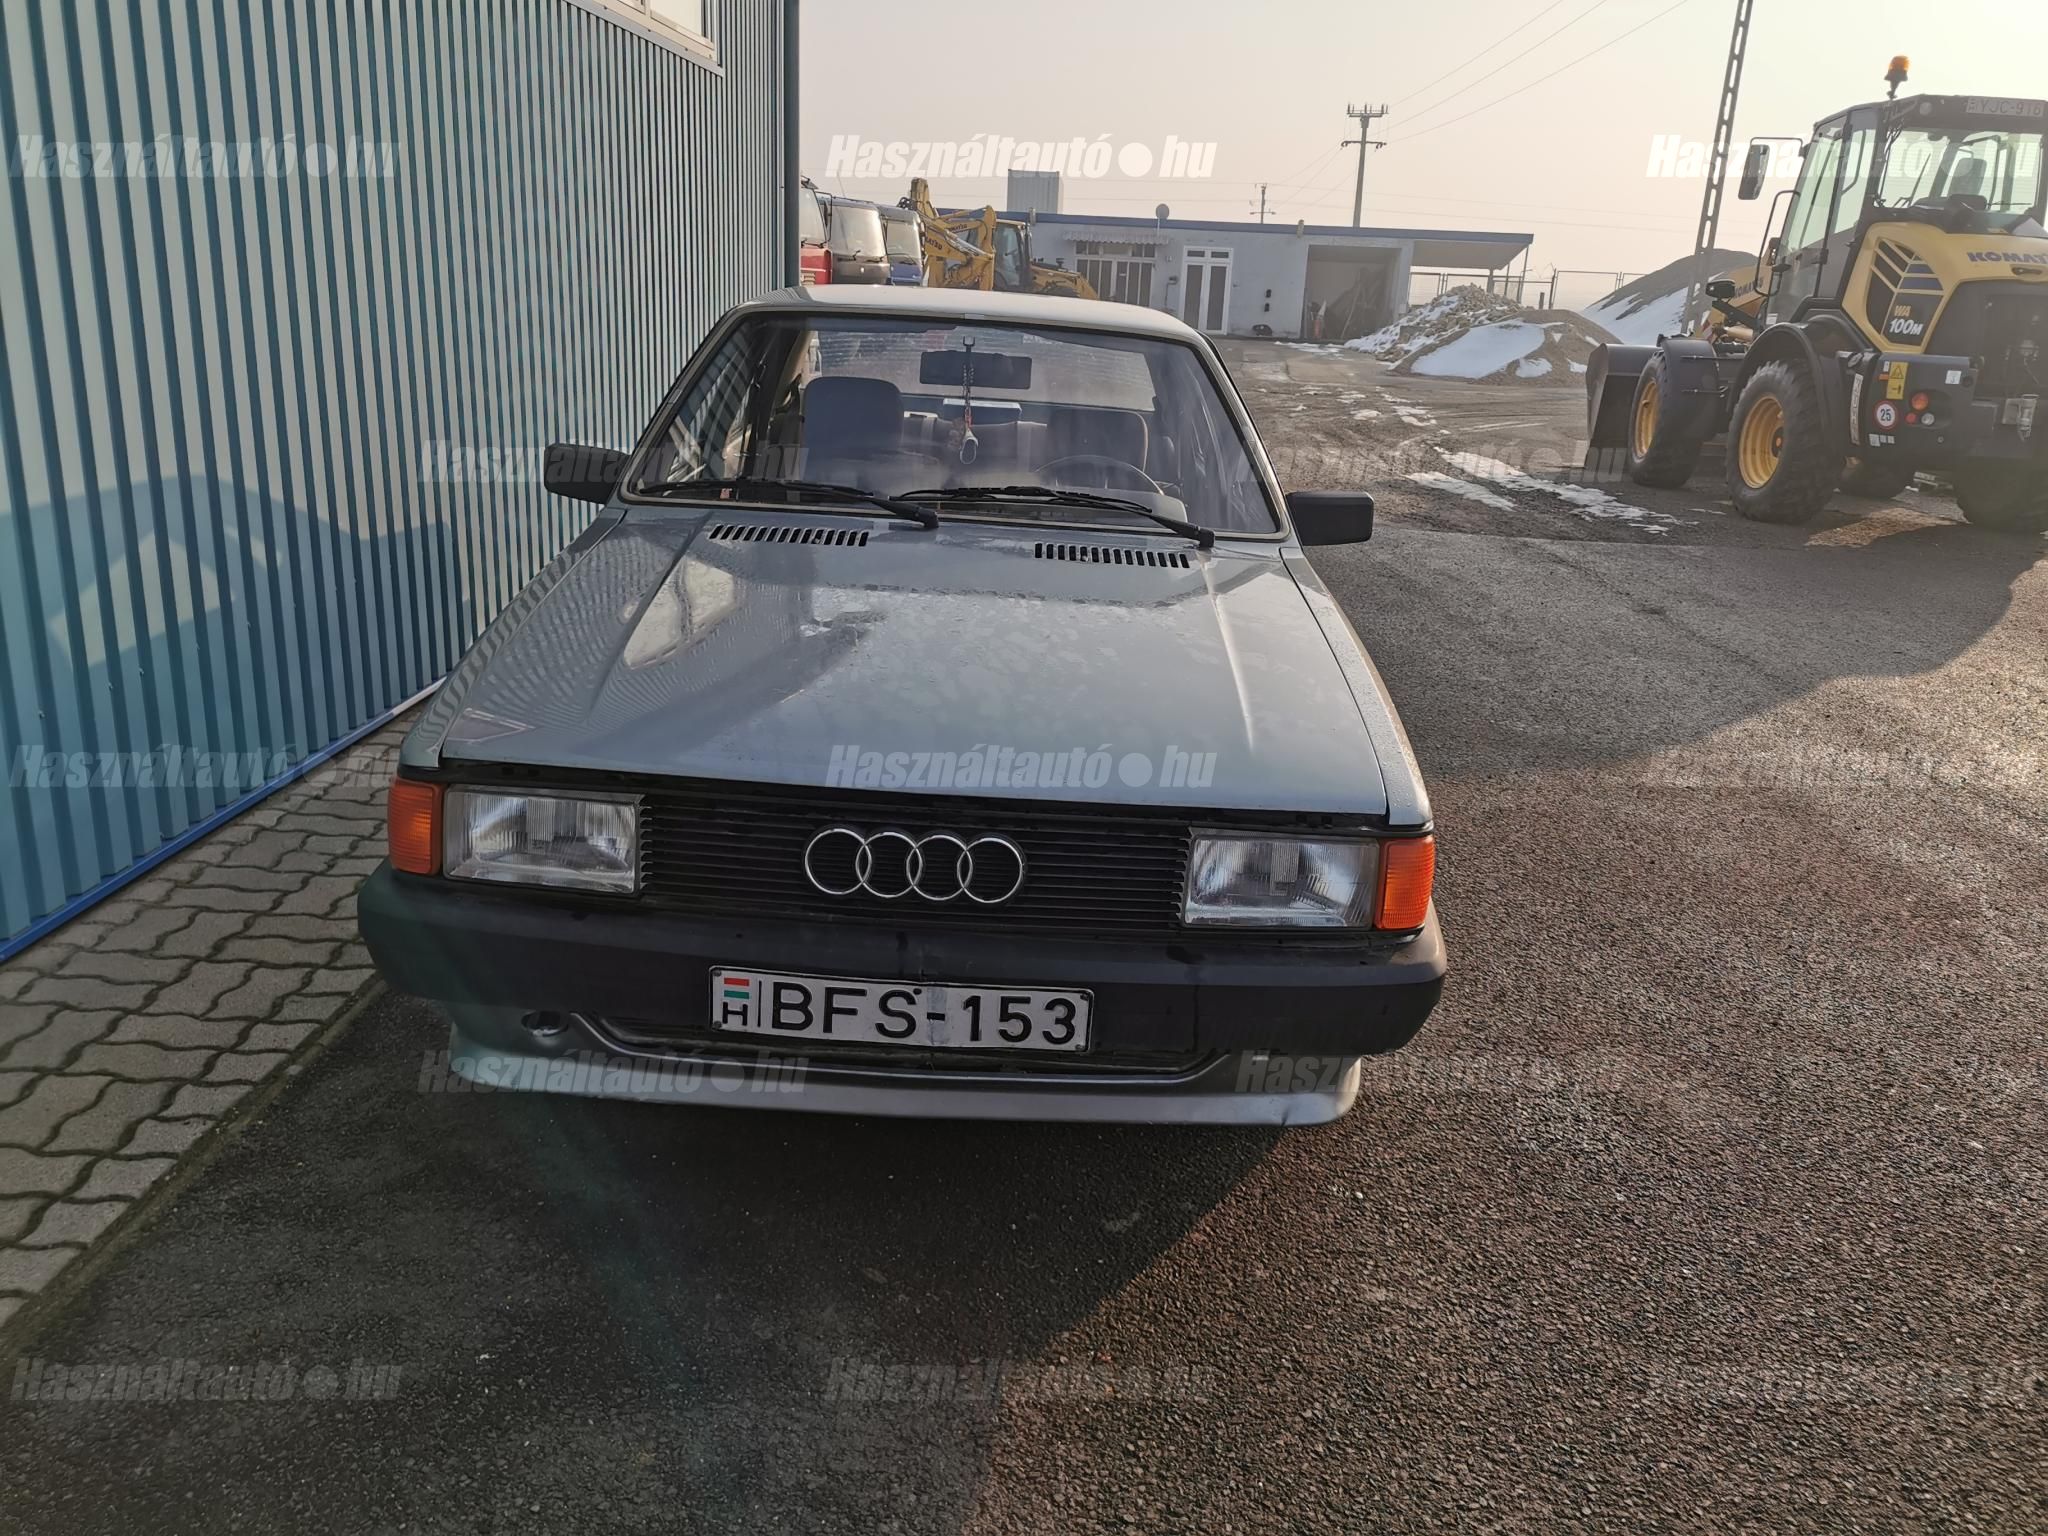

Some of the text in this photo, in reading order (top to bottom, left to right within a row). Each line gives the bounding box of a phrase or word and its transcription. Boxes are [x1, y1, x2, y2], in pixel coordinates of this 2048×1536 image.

[1889, 318, 1924, 335] 100M
[1880, 408, 1892, 422] 25
[722, 981, 1077, 1045] H BFS-153
